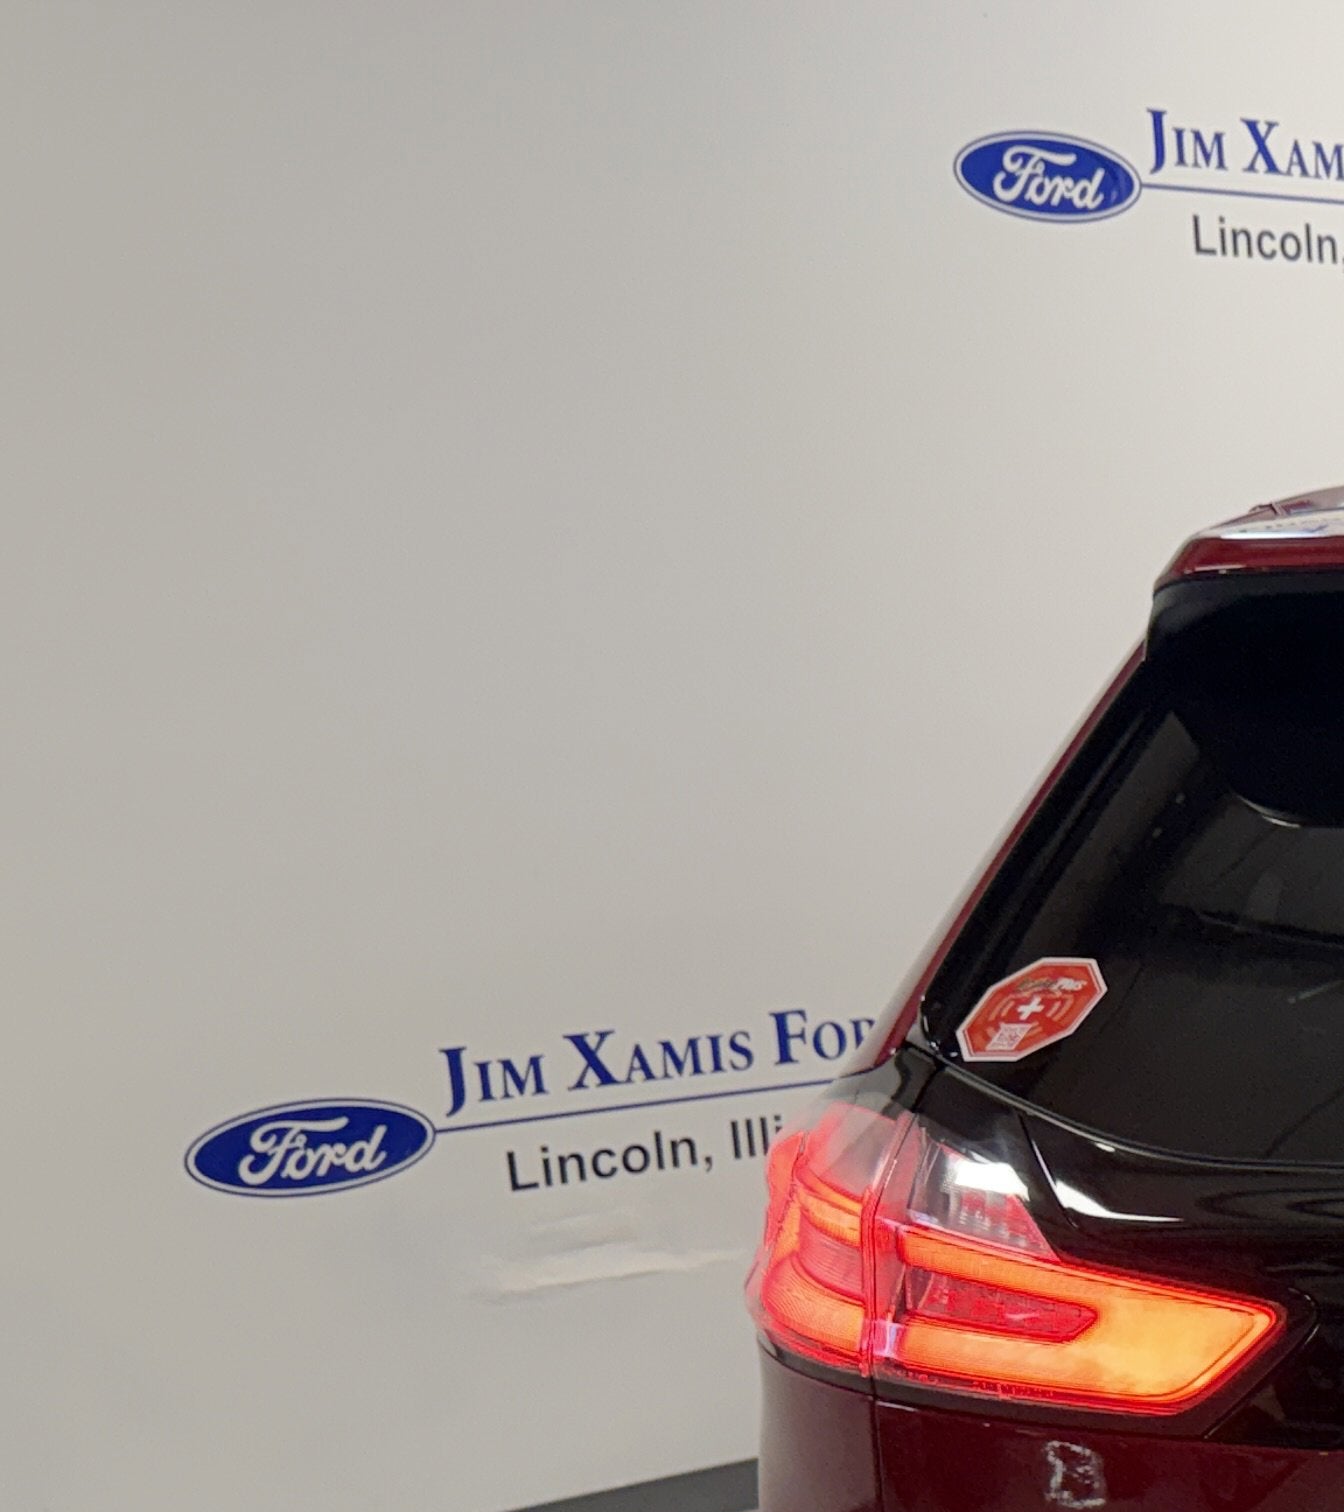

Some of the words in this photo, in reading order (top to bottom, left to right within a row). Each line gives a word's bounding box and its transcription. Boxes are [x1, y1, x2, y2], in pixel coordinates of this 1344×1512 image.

[1147, 109, 1228, 174] JIM
[993, 145, 1104, 209] Ford
[439, 1047, 549, 1117] JIM
[562, 1028, 754, 1090] XAMIS
[238, 1117, 386, 1184] Ford
[506, 1130, 713, 1192] Lincoln,
